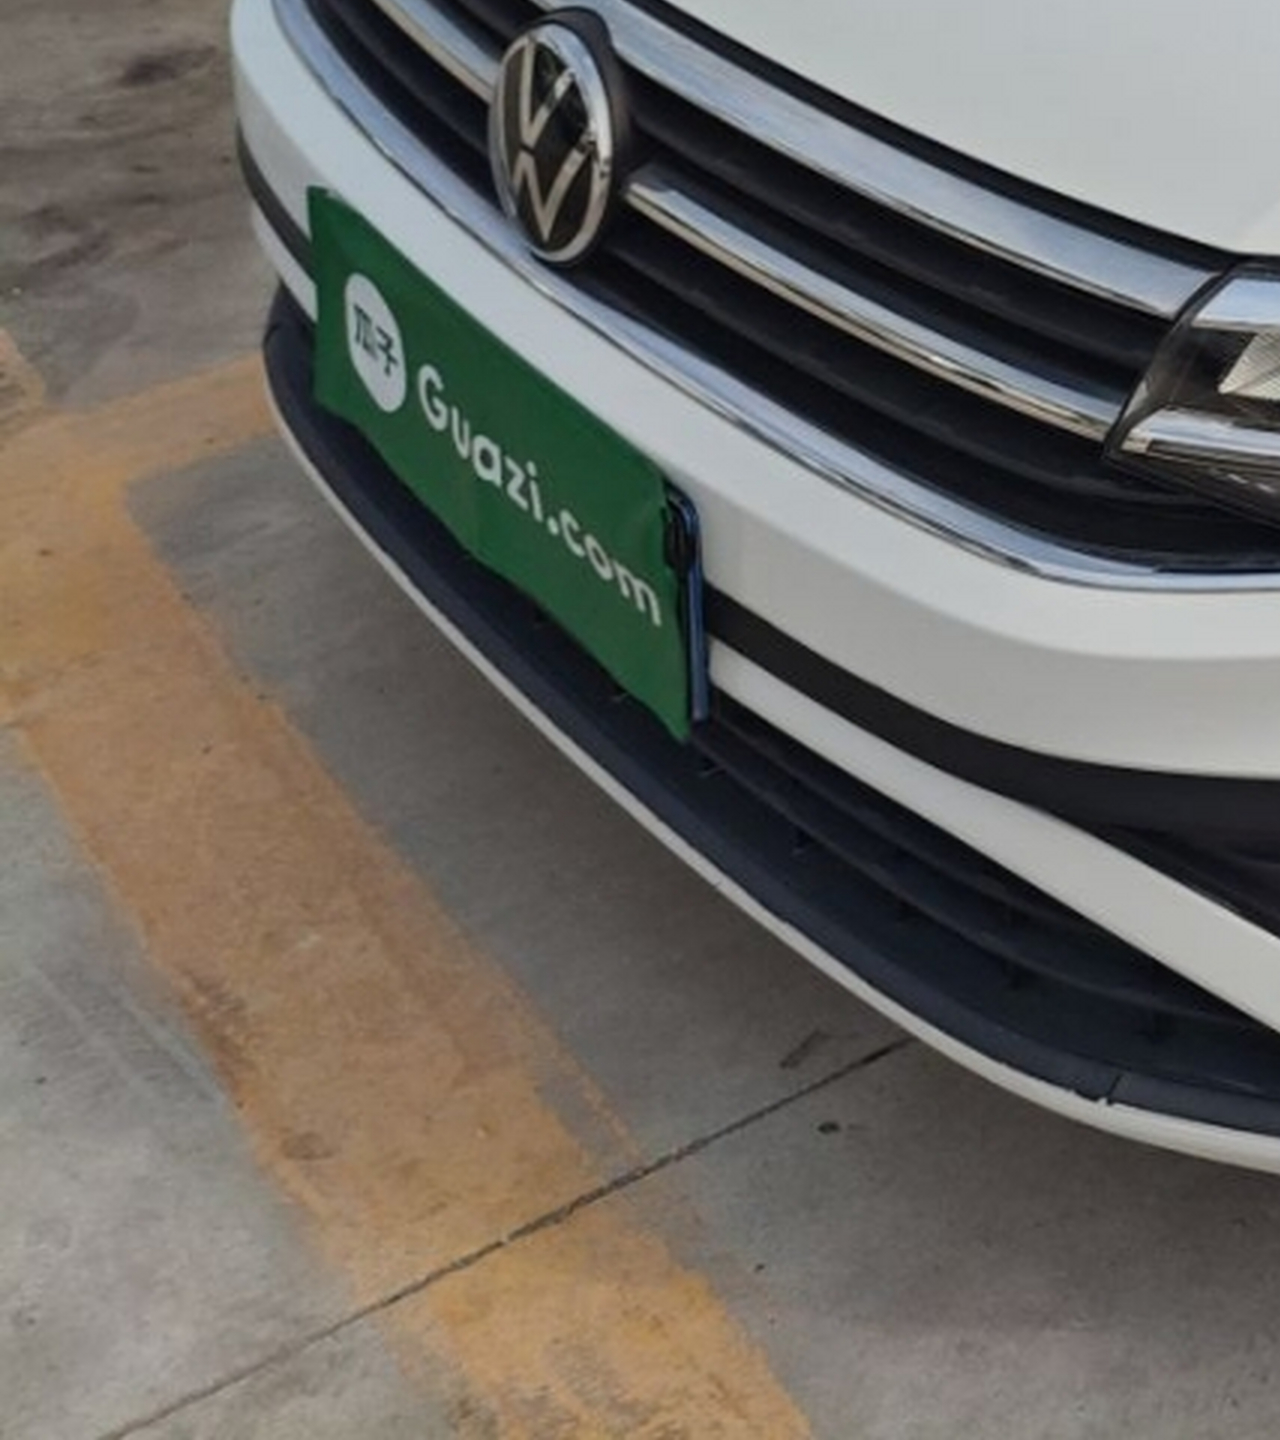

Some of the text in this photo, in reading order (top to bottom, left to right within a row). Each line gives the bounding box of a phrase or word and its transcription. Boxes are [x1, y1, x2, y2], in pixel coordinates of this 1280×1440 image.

[504, 35, 602, 250] VW
[353, 303, 399, 377] 瓜子
[418, 364, 661, 627] Guazi.com
